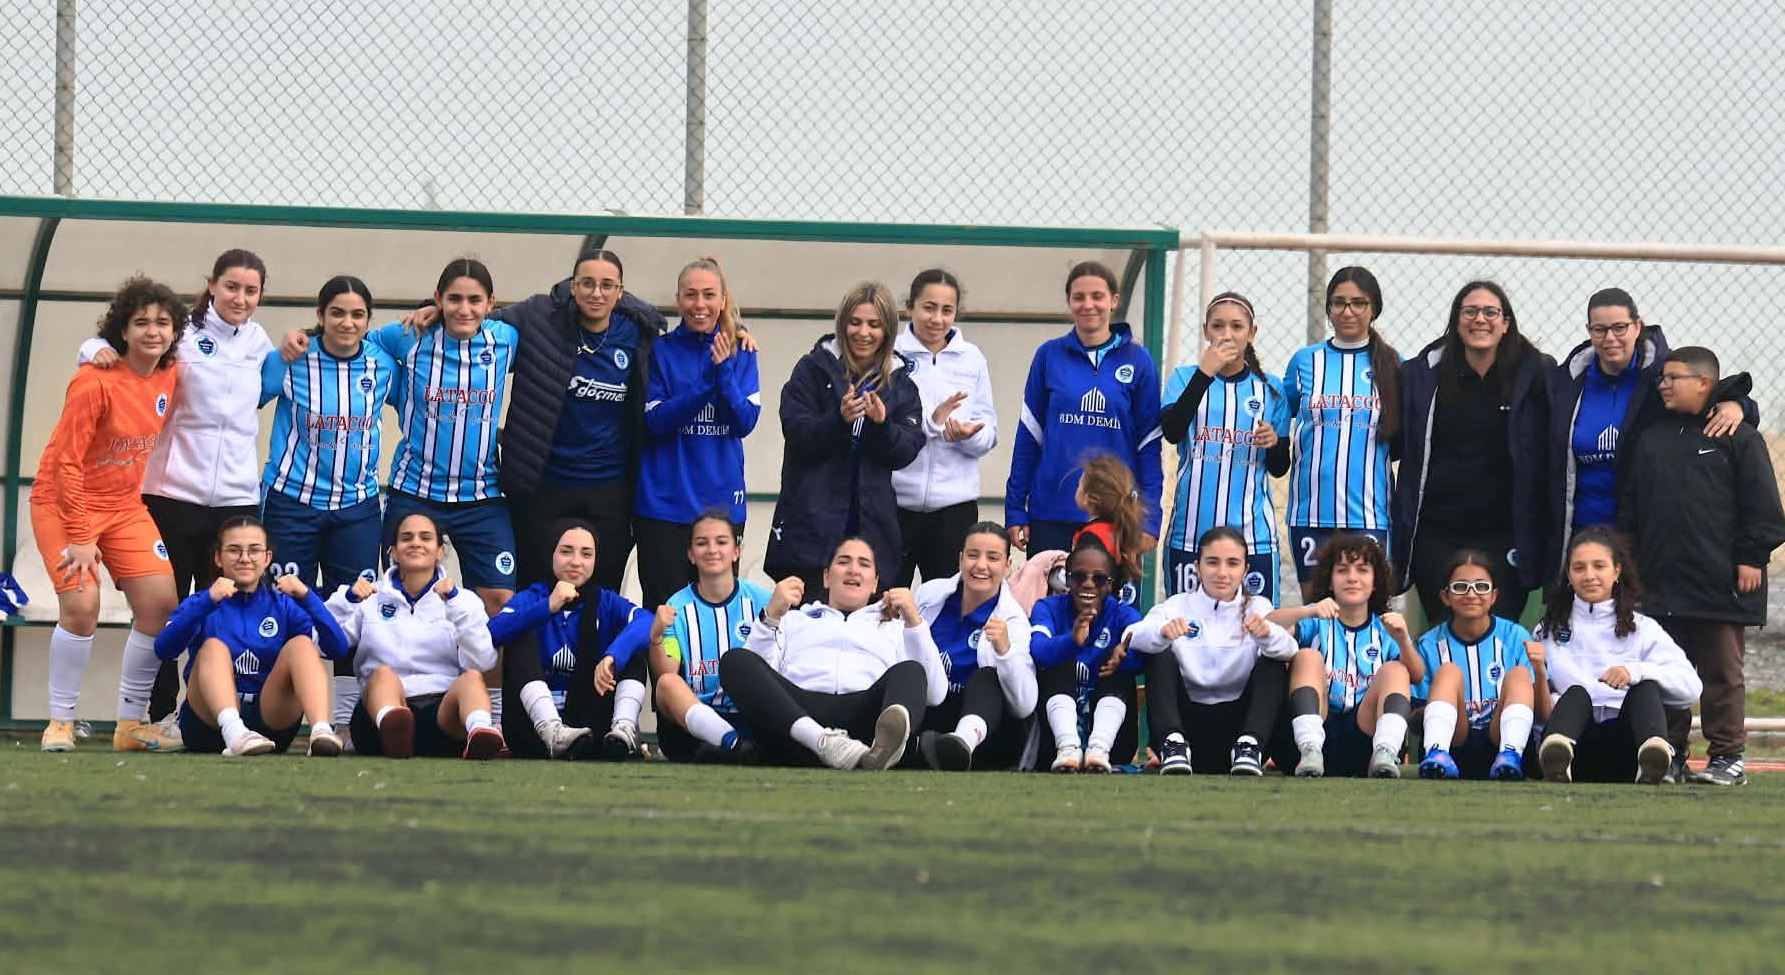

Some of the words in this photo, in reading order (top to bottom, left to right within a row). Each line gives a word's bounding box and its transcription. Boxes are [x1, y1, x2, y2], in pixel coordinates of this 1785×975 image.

[425, 386, 496, 404] LATACCO
[1059, 413, 1084, 425] BDM
[733, 489, 744, 505] 77
[1175, 562, 1198, 594] 16
[689, 659, 721, 676] LAT
